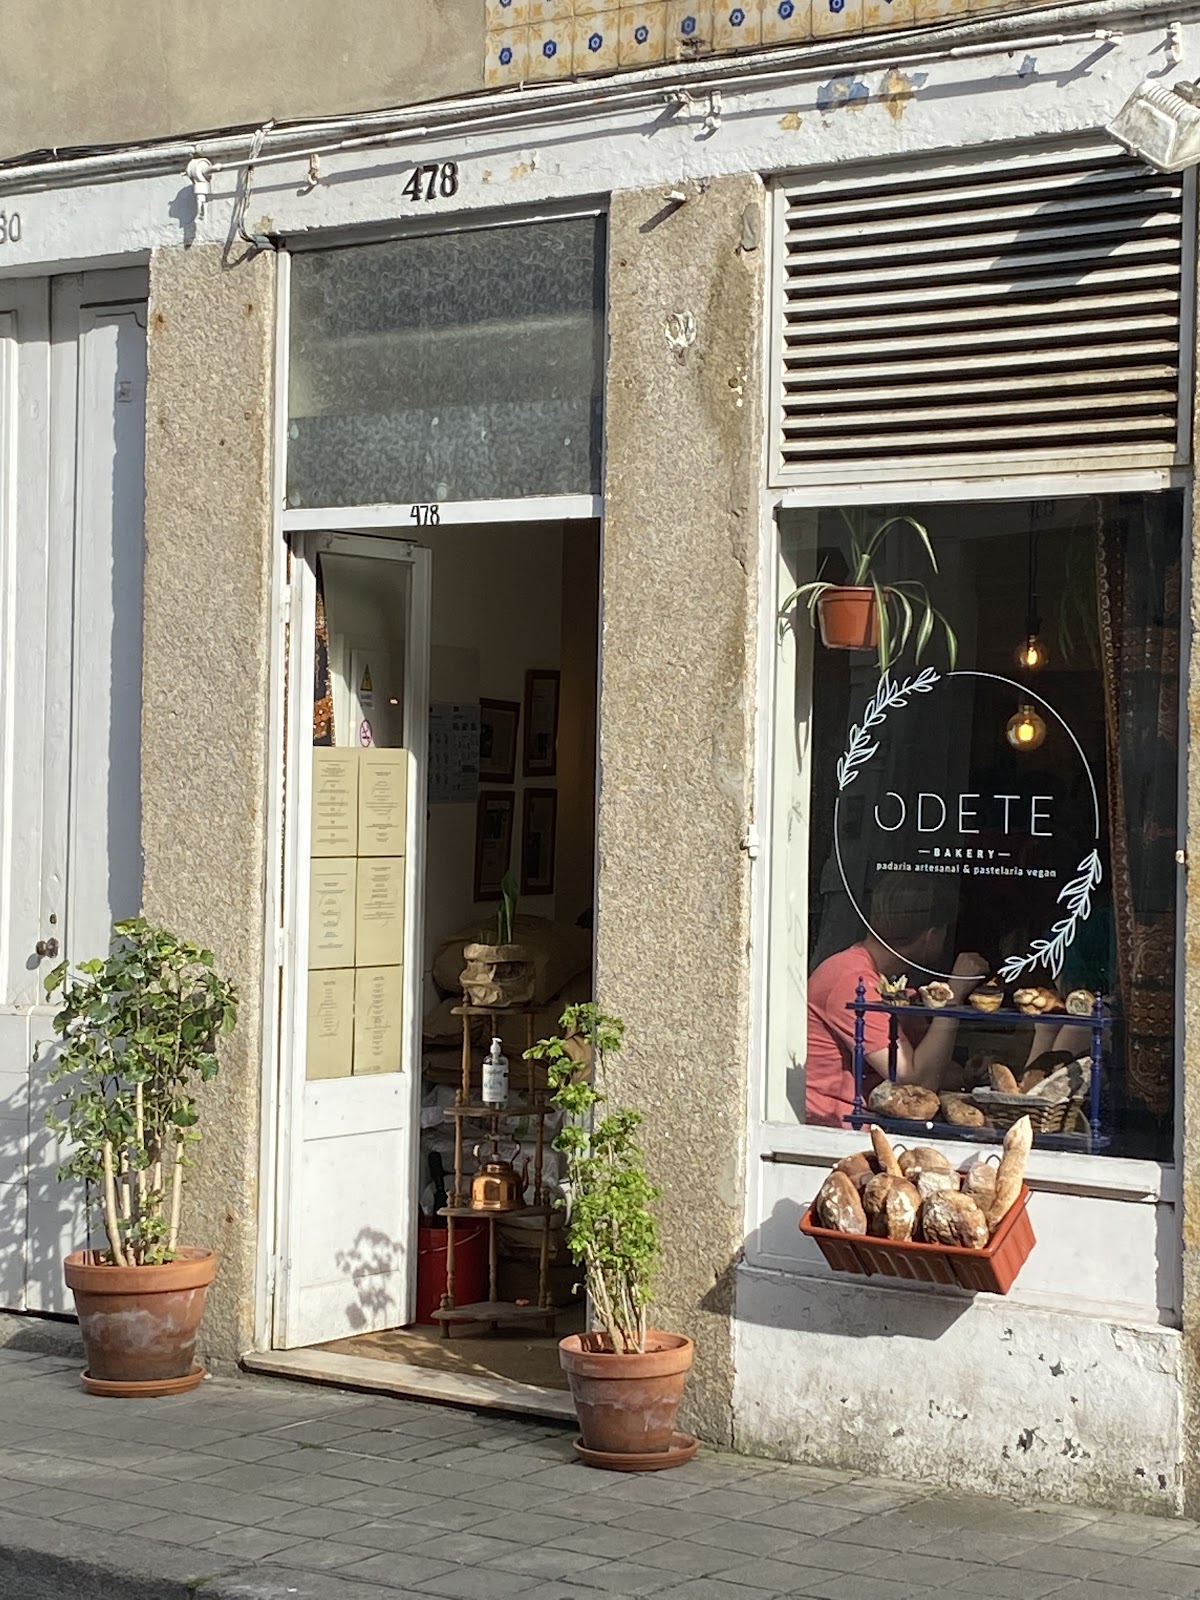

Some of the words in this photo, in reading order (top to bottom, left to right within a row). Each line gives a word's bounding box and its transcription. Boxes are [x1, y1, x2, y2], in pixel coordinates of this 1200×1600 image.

[401, 162, 459, 202] 478
[410, 504, 440, 527] 478
[874, 791, 1053, 836] ODETE
[933, 847, 995, 859] BAKERY
[876, 861, 912, 871] padaria
[914, 862, 960, 873] artesanal
[962, 864, 971, 874] &
[973, 865, 1023, 876] pastelaria
[1026, 868, 1057, 878] vegan
